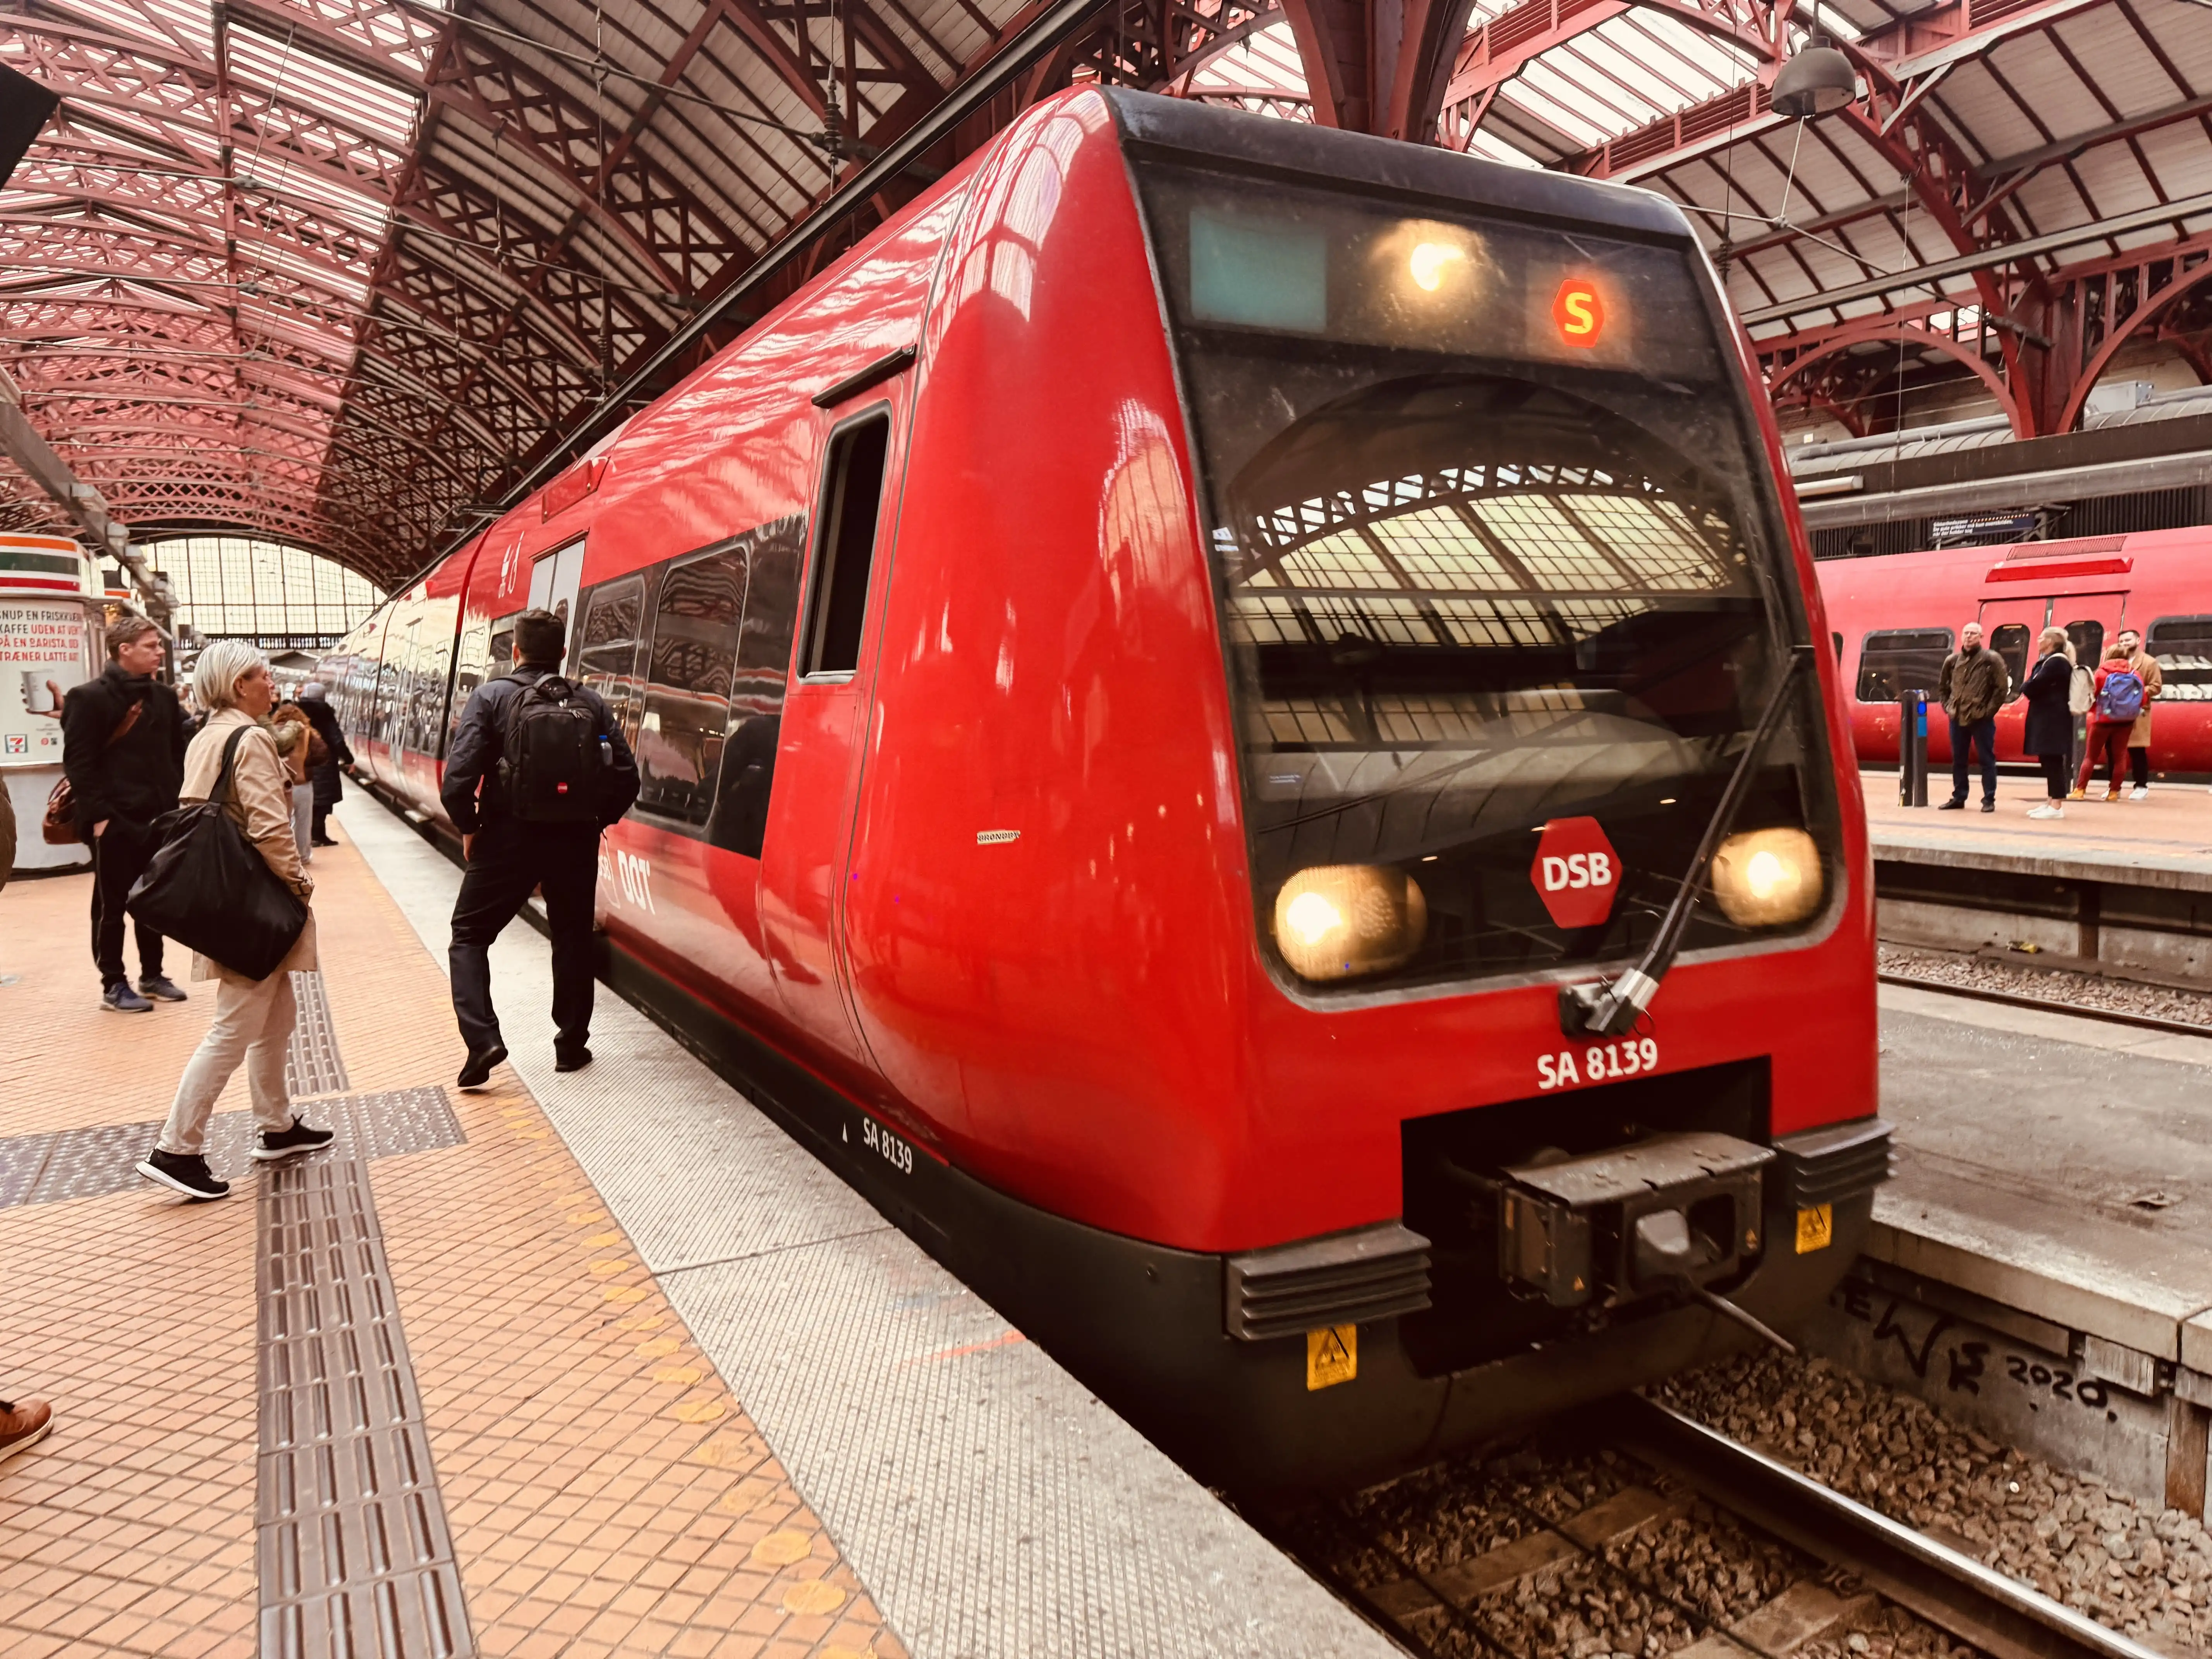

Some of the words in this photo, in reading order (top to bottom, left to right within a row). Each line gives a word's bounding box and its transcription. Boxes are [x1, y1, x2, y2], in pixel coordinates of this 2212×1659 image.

[1565, 292, 1594, 334] S
[0, 610, 23, 620] NUP
[26, 611, 38, 620] EN
[31, 624, 55, 634] UDEN
[14, 638, 27, 647] EN
[44, 651, 67, 662] LATTE
[1542, 852, 1612, 891] DSB
[1537, 1051, 1580, 1089] SA
[1586, 1037, 1658, 1080] 8139
[863, 1117, 879, 1153] SA
[882, 1130, 912, 1175] 8139
